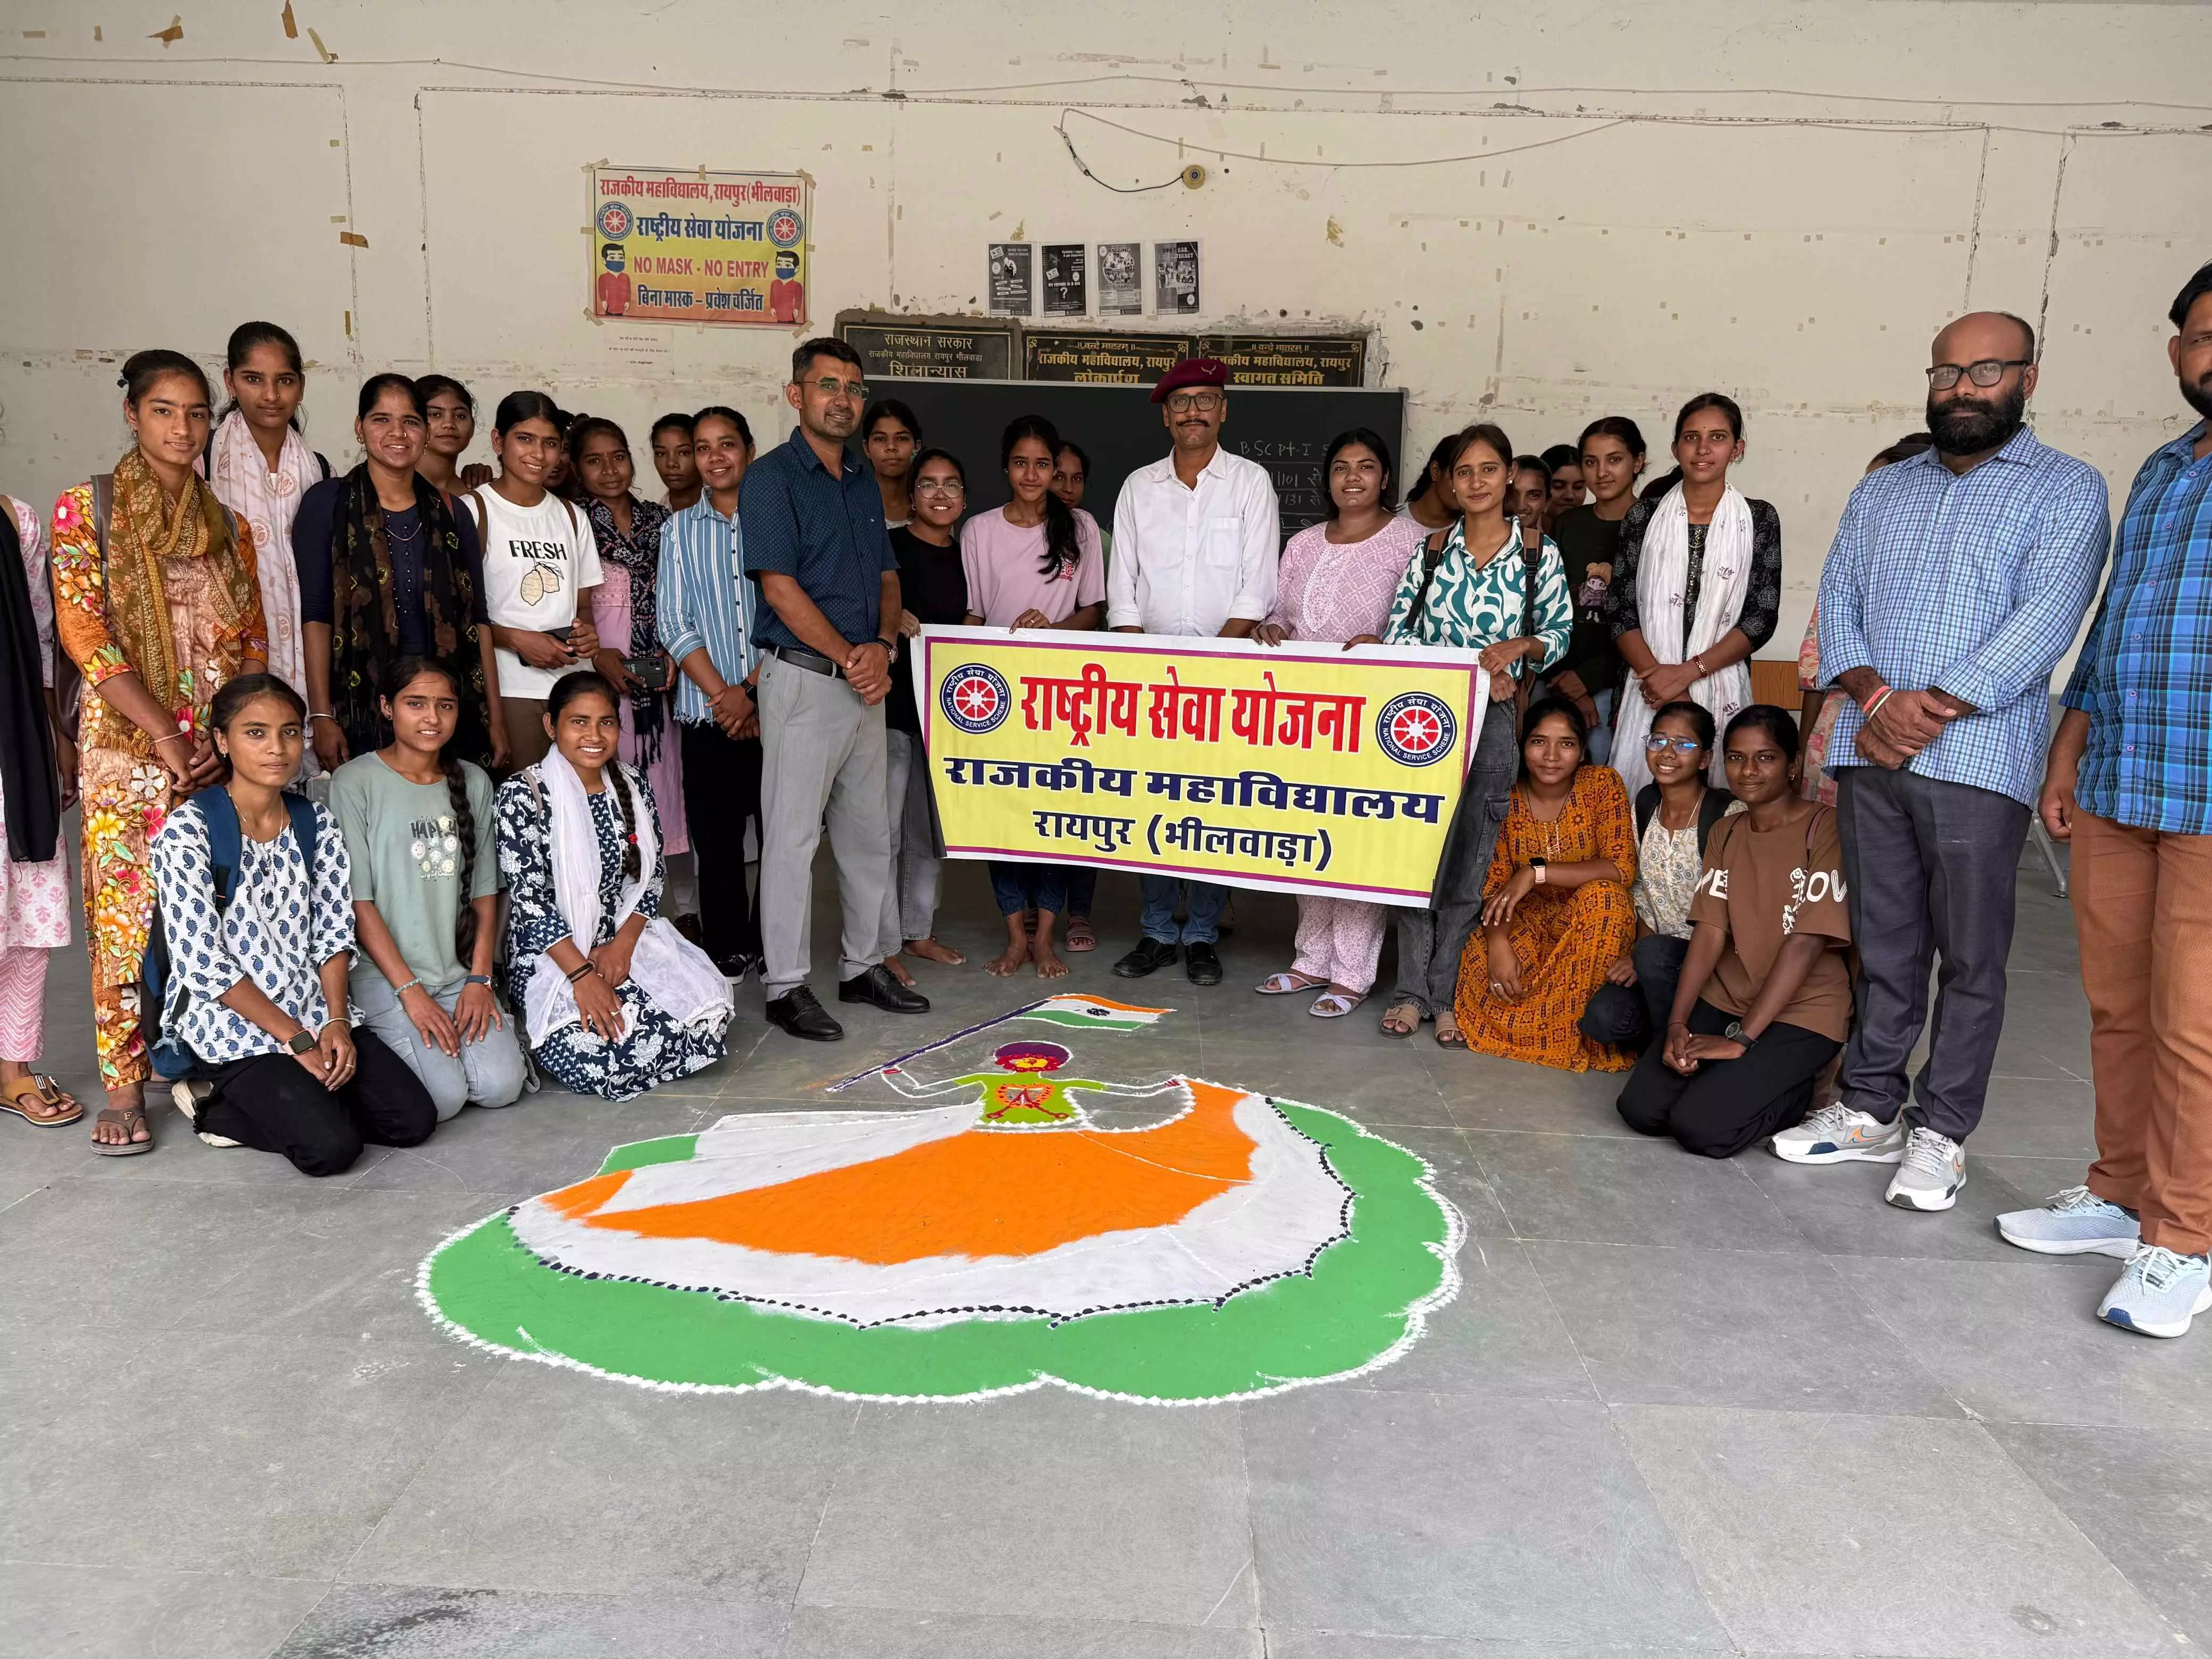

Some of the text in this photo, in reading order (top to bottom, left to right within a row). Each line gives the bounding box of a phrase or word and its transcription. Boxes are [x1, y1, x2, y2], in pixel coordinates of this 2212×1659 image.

[600, 176, 644, 197] राजकीय
[636, 212, 682, 241] राष्ट्रीय
[684, 213, 713, 239] सेवा
[715, 214, 764, 241] योजना
[634, 256, 652, 273] NO
[657, 257, 693, 275] MASK
[705, 259, 723, 276] NO
[727, 260, 769, 278] ENTRY
[638, 284, 663, 306] बिना
[705, 287, 731, 309] प्रवेश
[732, 289, 764, 311] वर्जित
[884, 334, 973, 349] राजस्थान सरकार
[868, 349, 893, 358] राजकीय
[934, 353, 953, 363] रायपुर
[1039, 351, 1078, 365] राजकीय
[1319, 357, 1351, 371] रायपुर
[889, 361, 968, 378] शिलान्यास
[1234, 371, 1325, 385] स्वागत समिति
[509, 540, 567, 560] FRESH
[946, 697, 963, 724] NATIONAL
[992, 701, 1006, 723] SCHEME
[1020, 663, 1366, 753] राष्ट्रीय सेवा योजना
[1383, 727, 1401, 756] NATIONAL
[1432, 733, 1450, 755] SCHEME
[943, 758, 1445, 824] राजकीय महाविद्यालय
[1033, 811, 1331, 872] रायपुर (भीलवाड़ा)
